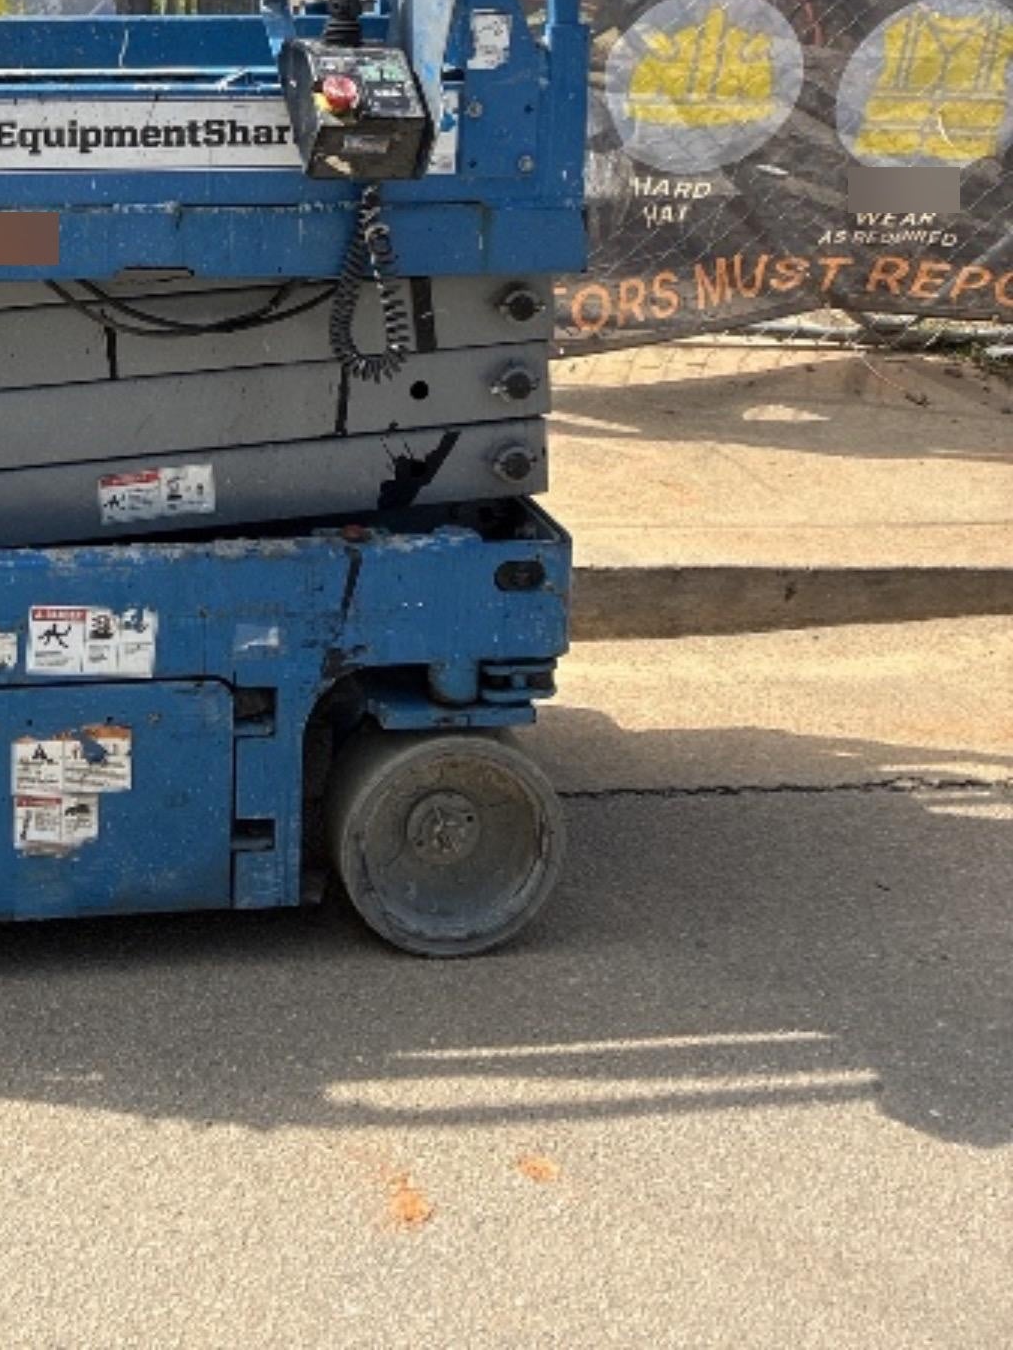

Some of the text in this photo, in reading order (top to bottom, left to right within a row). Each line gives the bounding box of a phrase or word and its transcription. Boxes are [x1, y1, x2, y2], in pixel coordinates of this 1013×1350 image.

[629, 176, 712, 200] HARD
[818, 229, 847, 246] AS
[554, 269, 682, 334] ORS
[694, 253, 855, 310] MUST
